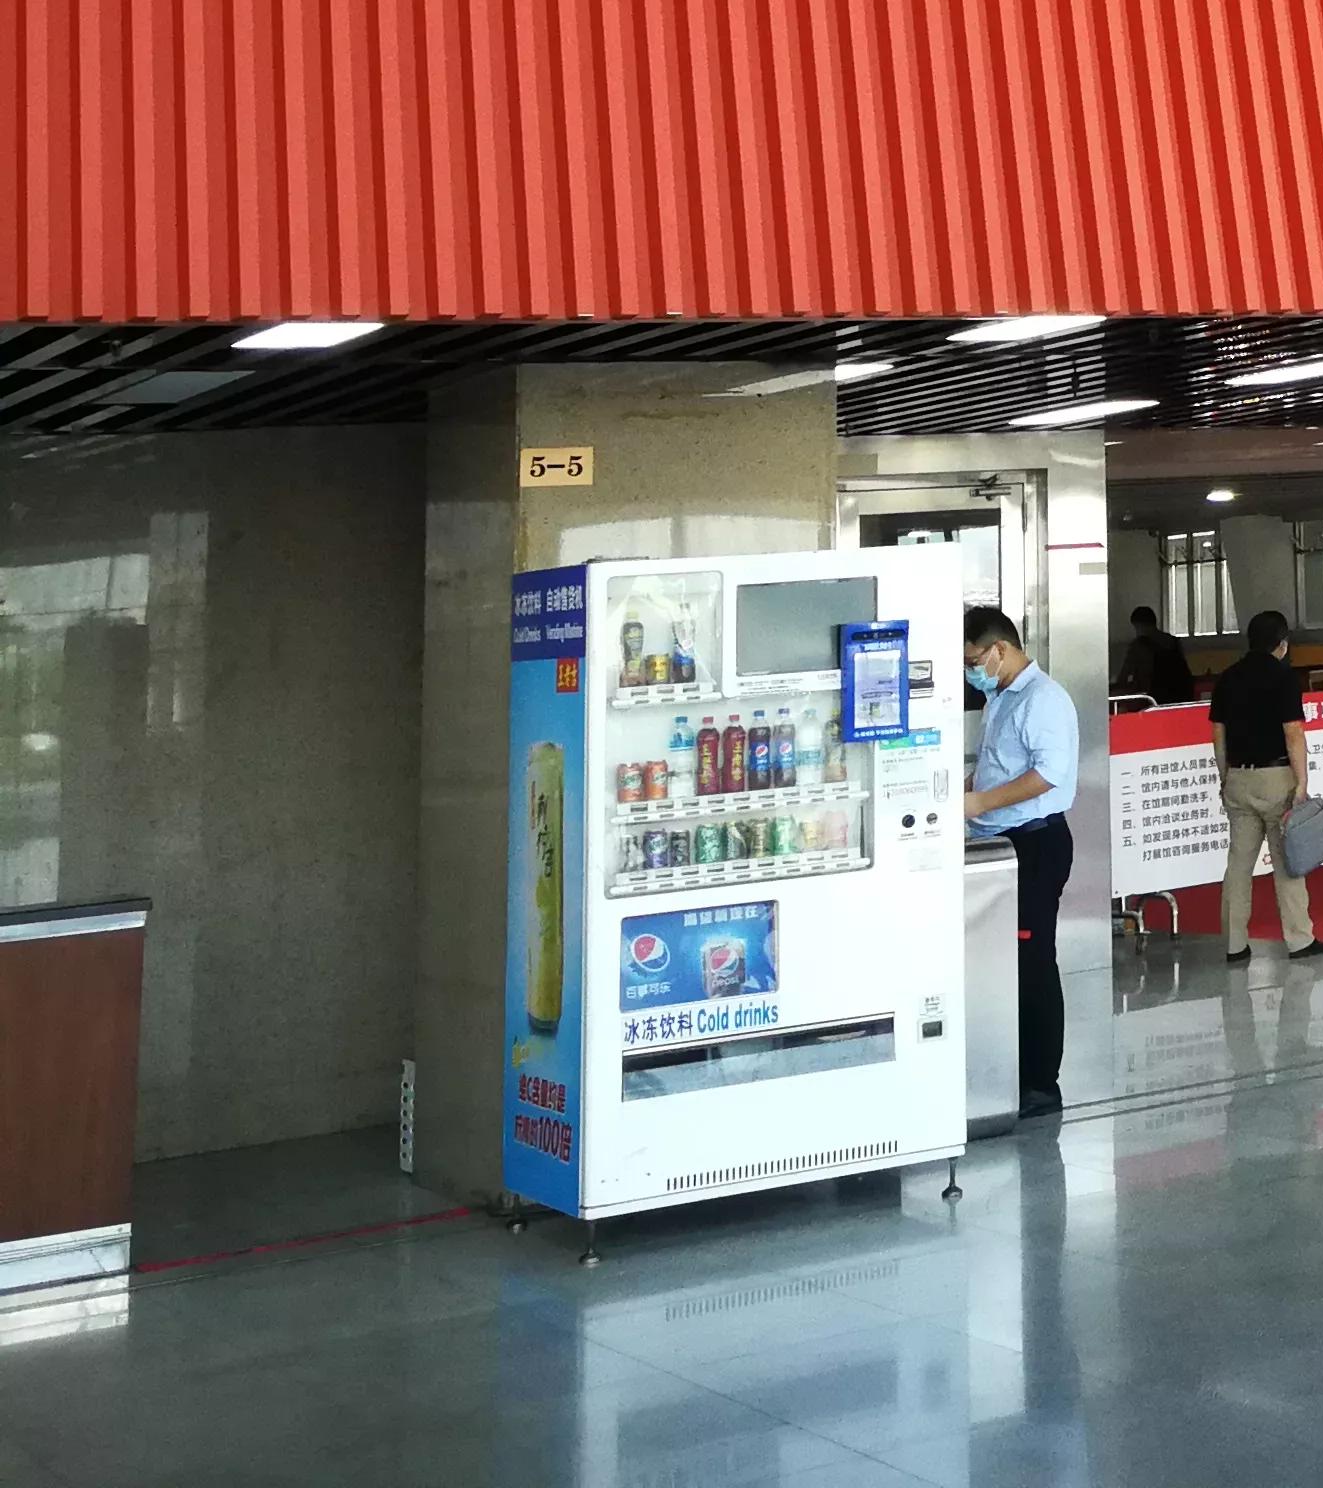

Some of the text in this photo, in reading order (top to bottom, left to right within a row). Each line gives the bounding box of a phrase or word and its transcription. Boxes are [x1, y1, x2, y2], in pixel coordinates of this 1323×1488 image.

[624, 1000, 779, 1044] 冰冻饮料 Cold drinks
